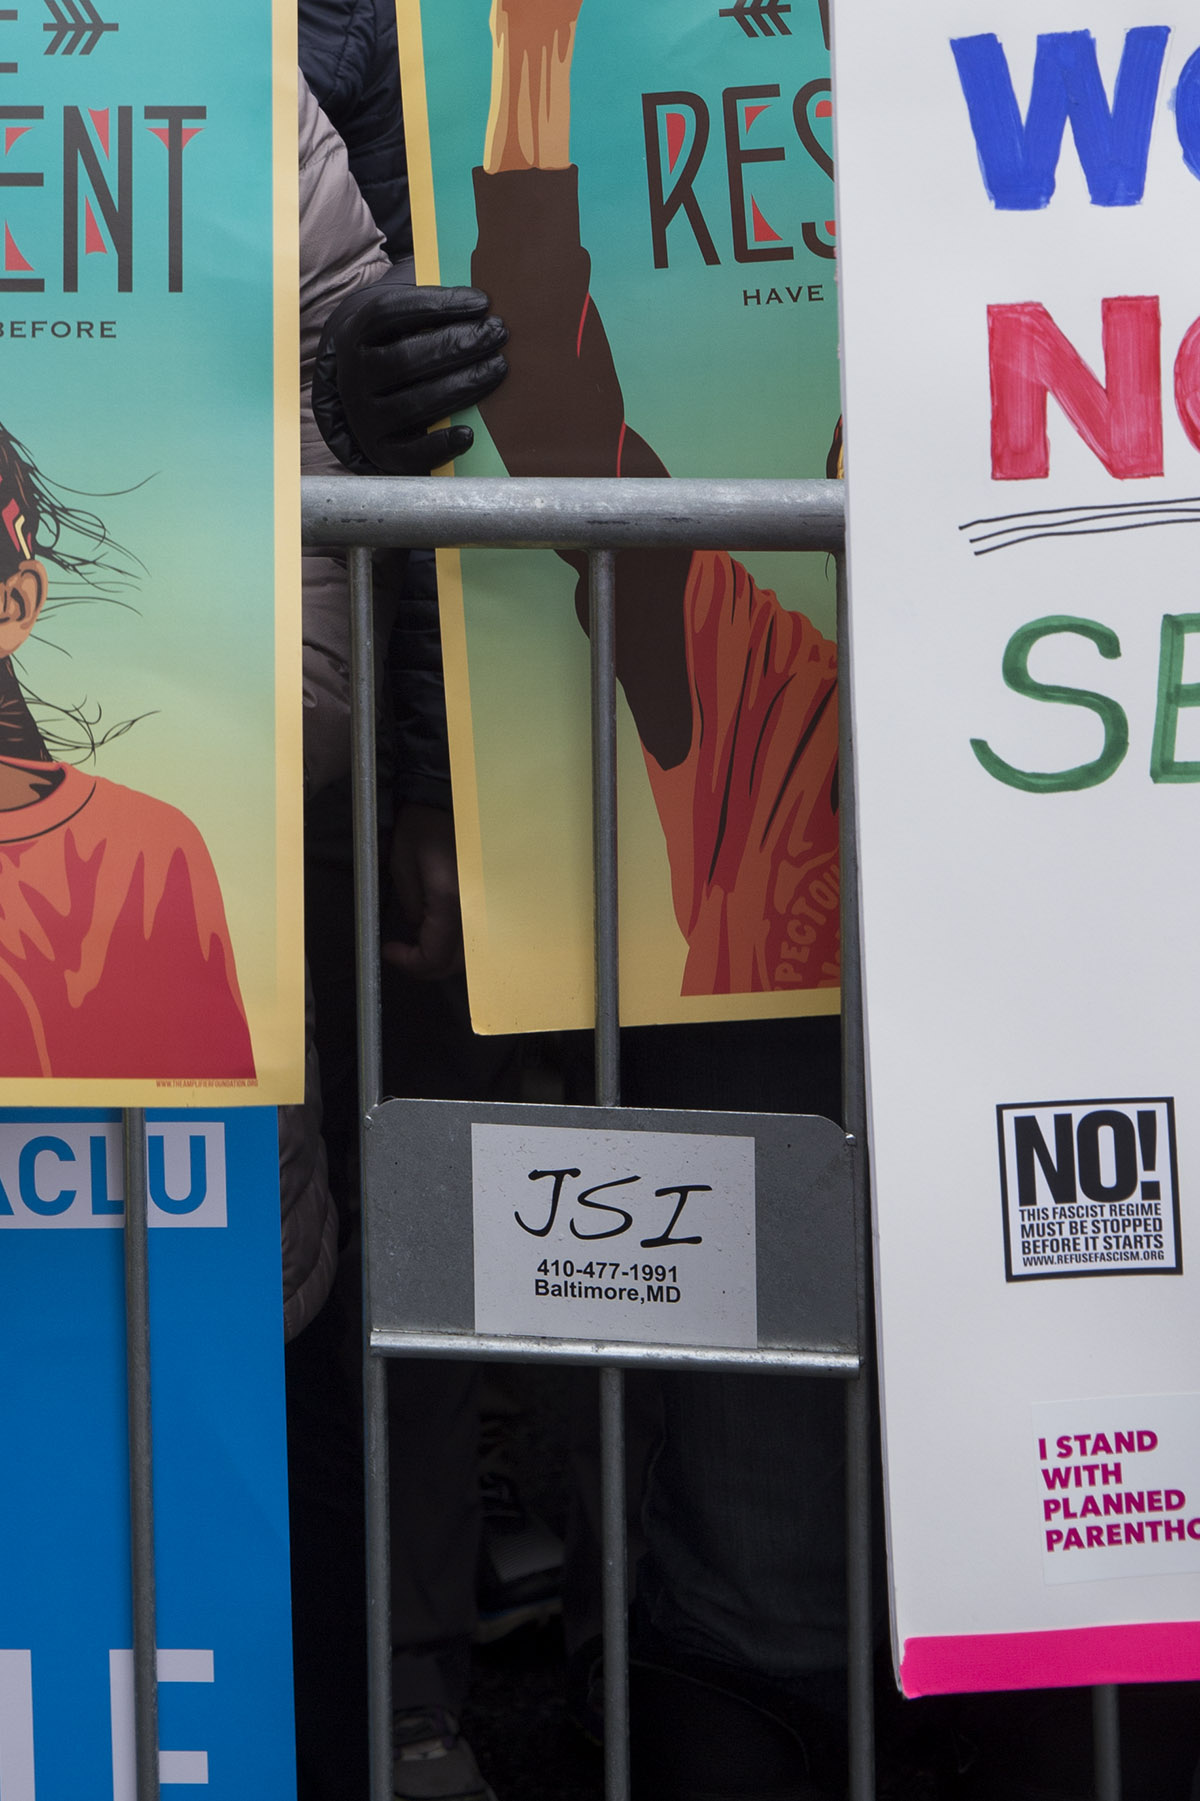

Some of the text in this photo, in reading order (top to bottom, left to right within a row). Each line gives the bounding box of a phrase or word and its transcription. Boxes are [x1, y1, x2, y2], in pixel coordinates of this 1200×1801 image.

[948, 25, 1200, 211] W
[743, 284, 824, 306] HAVE
[986, 294, 1200, 481] N
[1014, 1110, 1161, 1207] NO!
[514, 1168, 712, 1248] JSI
[1019, 1203, 1161, 1222] THIS FASCIST REGIME
[1021, 1217, 1163, 1239] MUST BE STOPPED
[1022, 1234, 1164, 1255] BEFORE IT STARTS
[537, 1259, 678, 1283] 410-477-1991
[1023, 1250, 1165, 1267] WWW.REFUSEFASCISM.ORG
[535, 1279, 681, 1305] Baltimore,MD
[1038, 1430, 1158, 1460] I STAND
[1041, 1462, 1122, 1491] WITH
[1043, 1489, 1186, 1522] PLANNED
